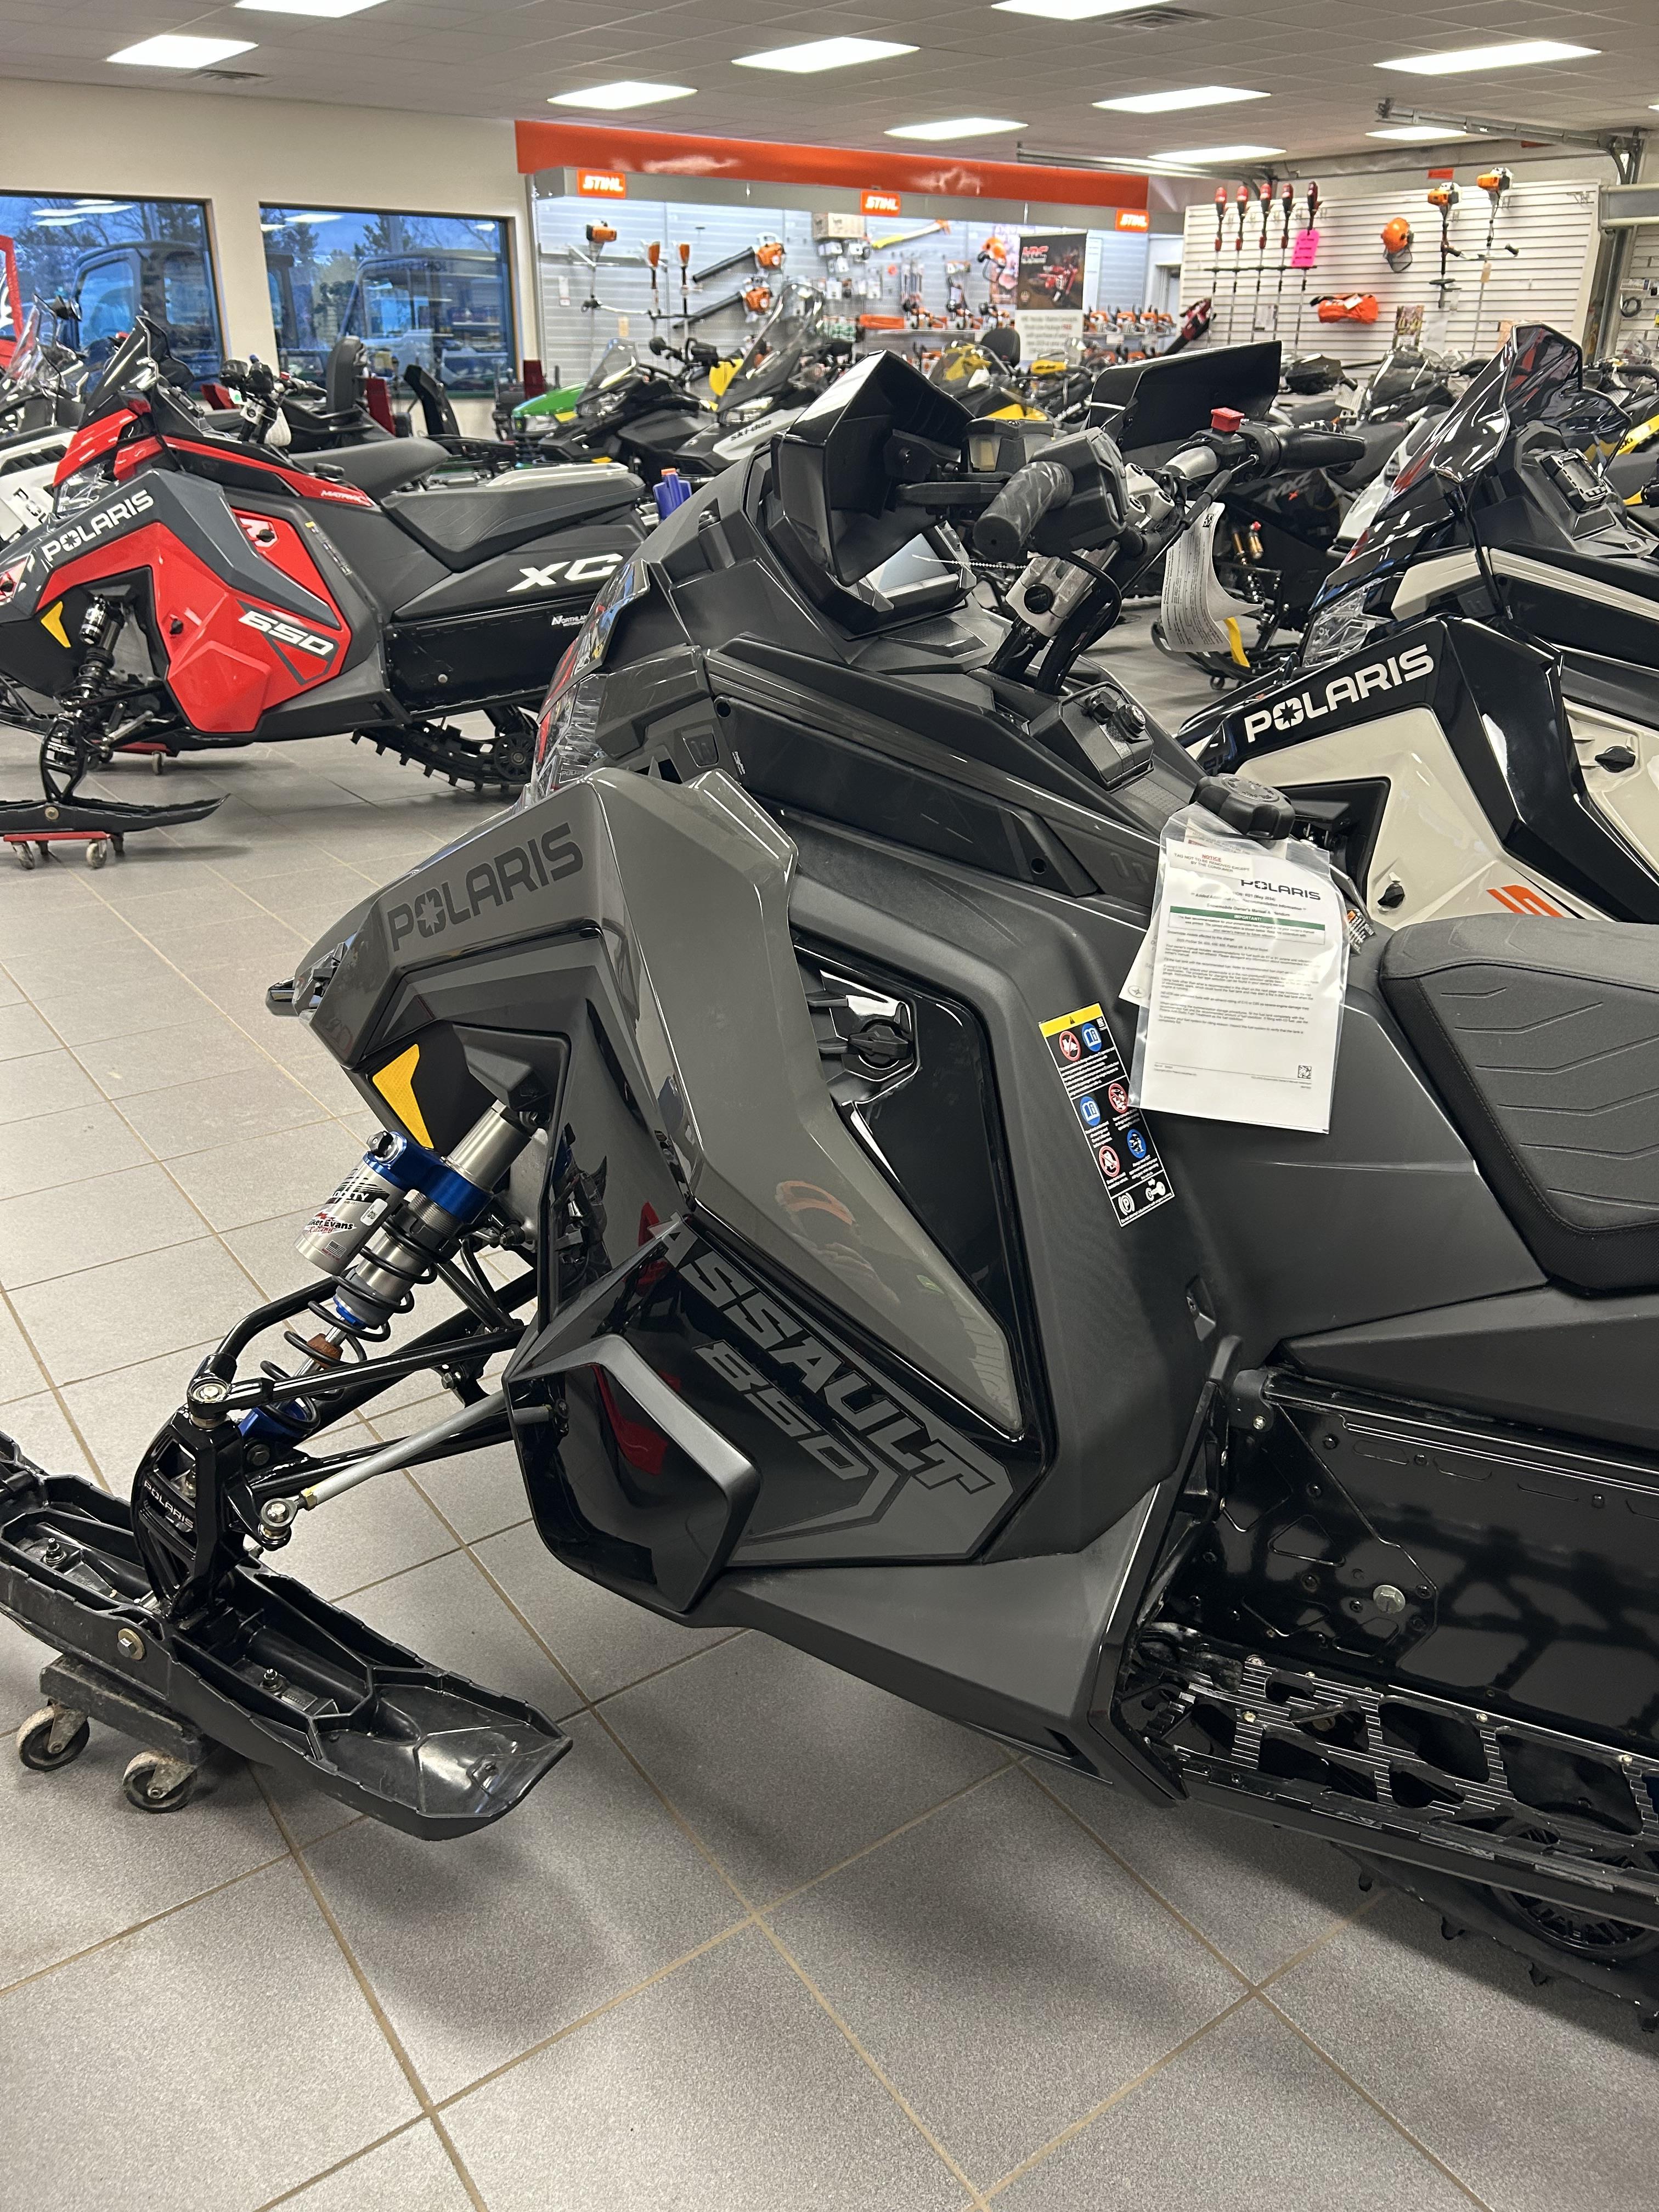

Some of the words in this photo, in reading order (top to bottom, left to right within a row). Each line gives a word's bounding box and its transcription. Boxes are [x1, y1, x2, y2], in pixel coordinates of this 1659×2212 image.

[583, 175, 624, 191] STIHL
[865, 196, 899, 211] STIHL
[1120, 214, 1147, 227] STIHL
[42, 489, 154, 562] POLARIS
[507, 554, 624, 592] XC
[551, 614, 588, 625] NORTHLAN
[238, 611, 334, 655] 650
[1244, 644, 1434, 743] POLARIS
[1202, 854, 1222, 862] NOTICE
[1207, 864, 1233, 872] CONSUMER
[1209, 860, 1231, 868] REMOVED
[387, 822, 583, 952] POLARIS
[1241, 879, 1321, 900] POLARIS
[324, 1218, 354, 1230] Evans
[647, 1210, 996, 1494] ASSAULT
[693, 1340, 871, 1480] 850
[143, 1479, 194, 1529] POLARIS
